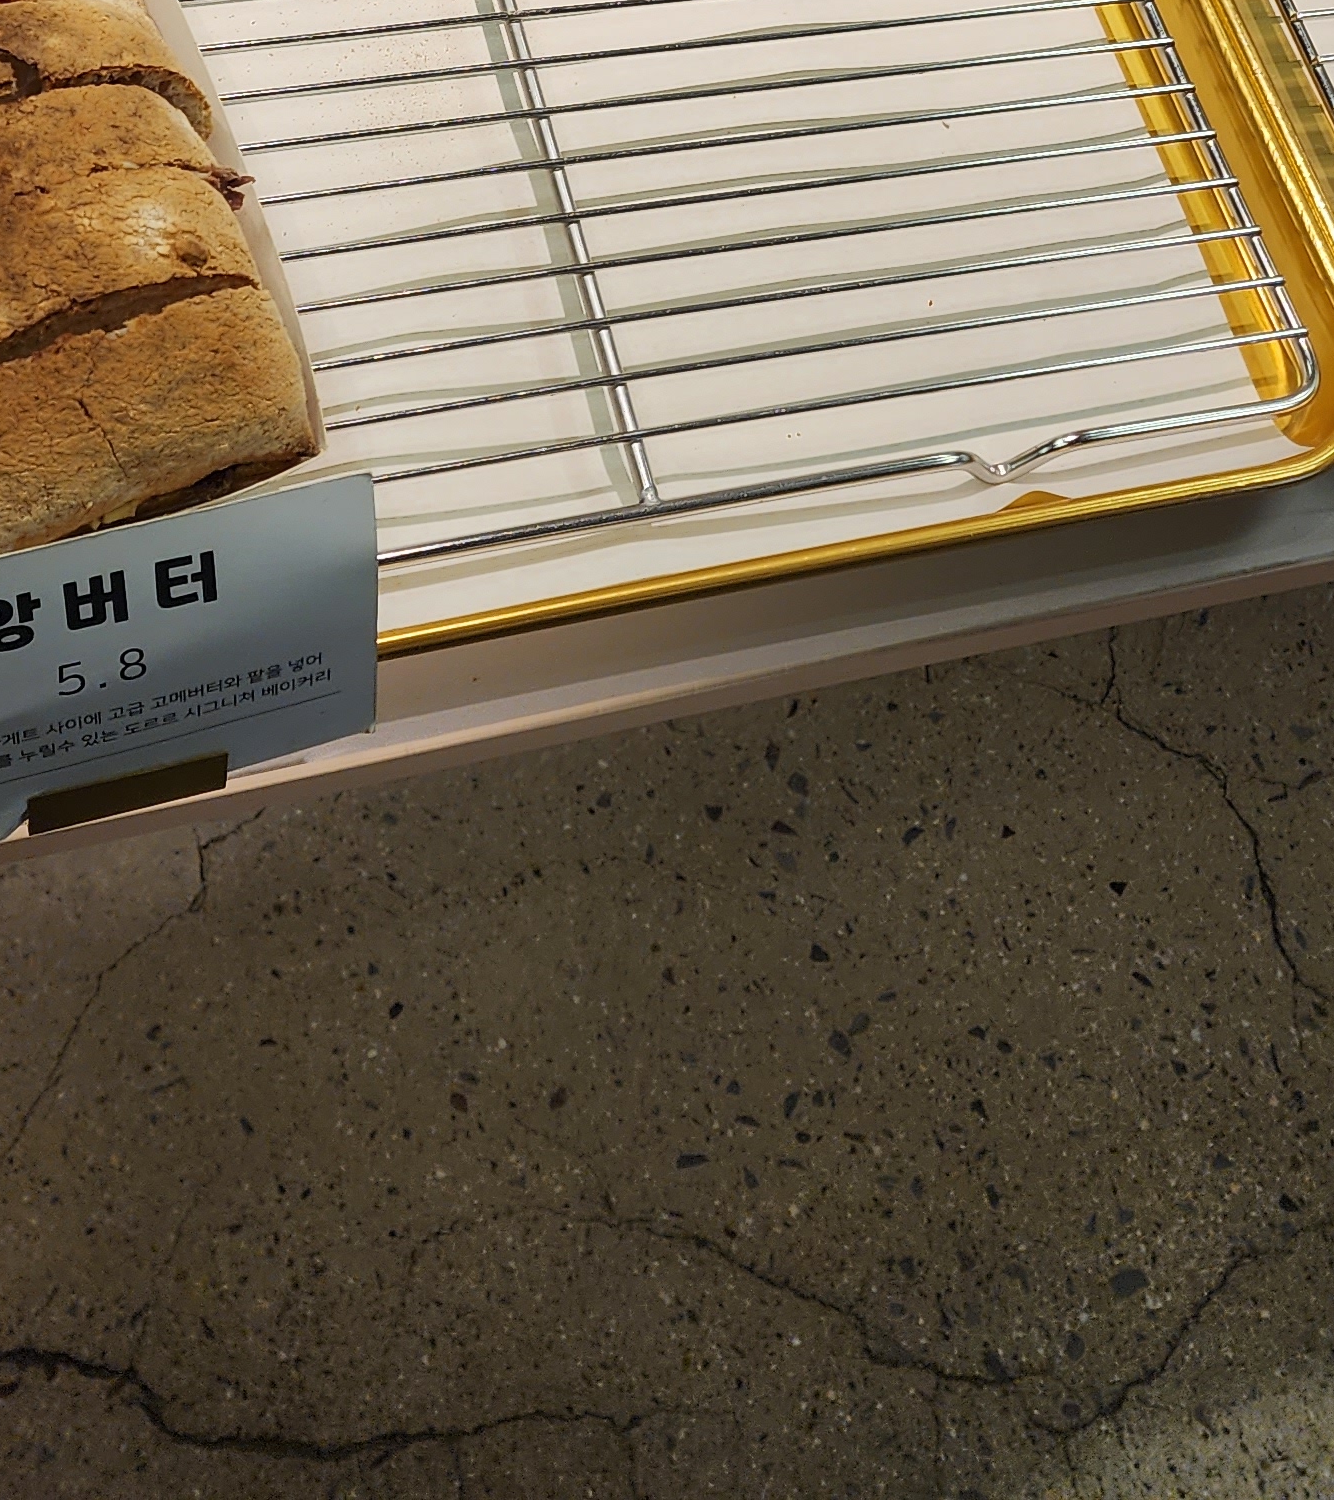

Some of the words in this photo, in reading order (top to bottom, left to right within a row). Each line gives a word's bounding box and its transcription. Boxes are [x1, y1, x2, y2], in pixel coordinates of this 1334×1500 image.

[46, 711, 102, 736] 사이에
[109, 701, 145, 721] 고급
[150, 674, 242, 710] 고메버터와
[247, 664, 282, 685] 팥을
[288, 651, 323, 673] 넣어
[57, 646, 148, 697] 5.8
[81, 730, 119, 747] 있는
[123, 712, 179, 736] 도르르
[261, 667, 332, 696] 베이커리
